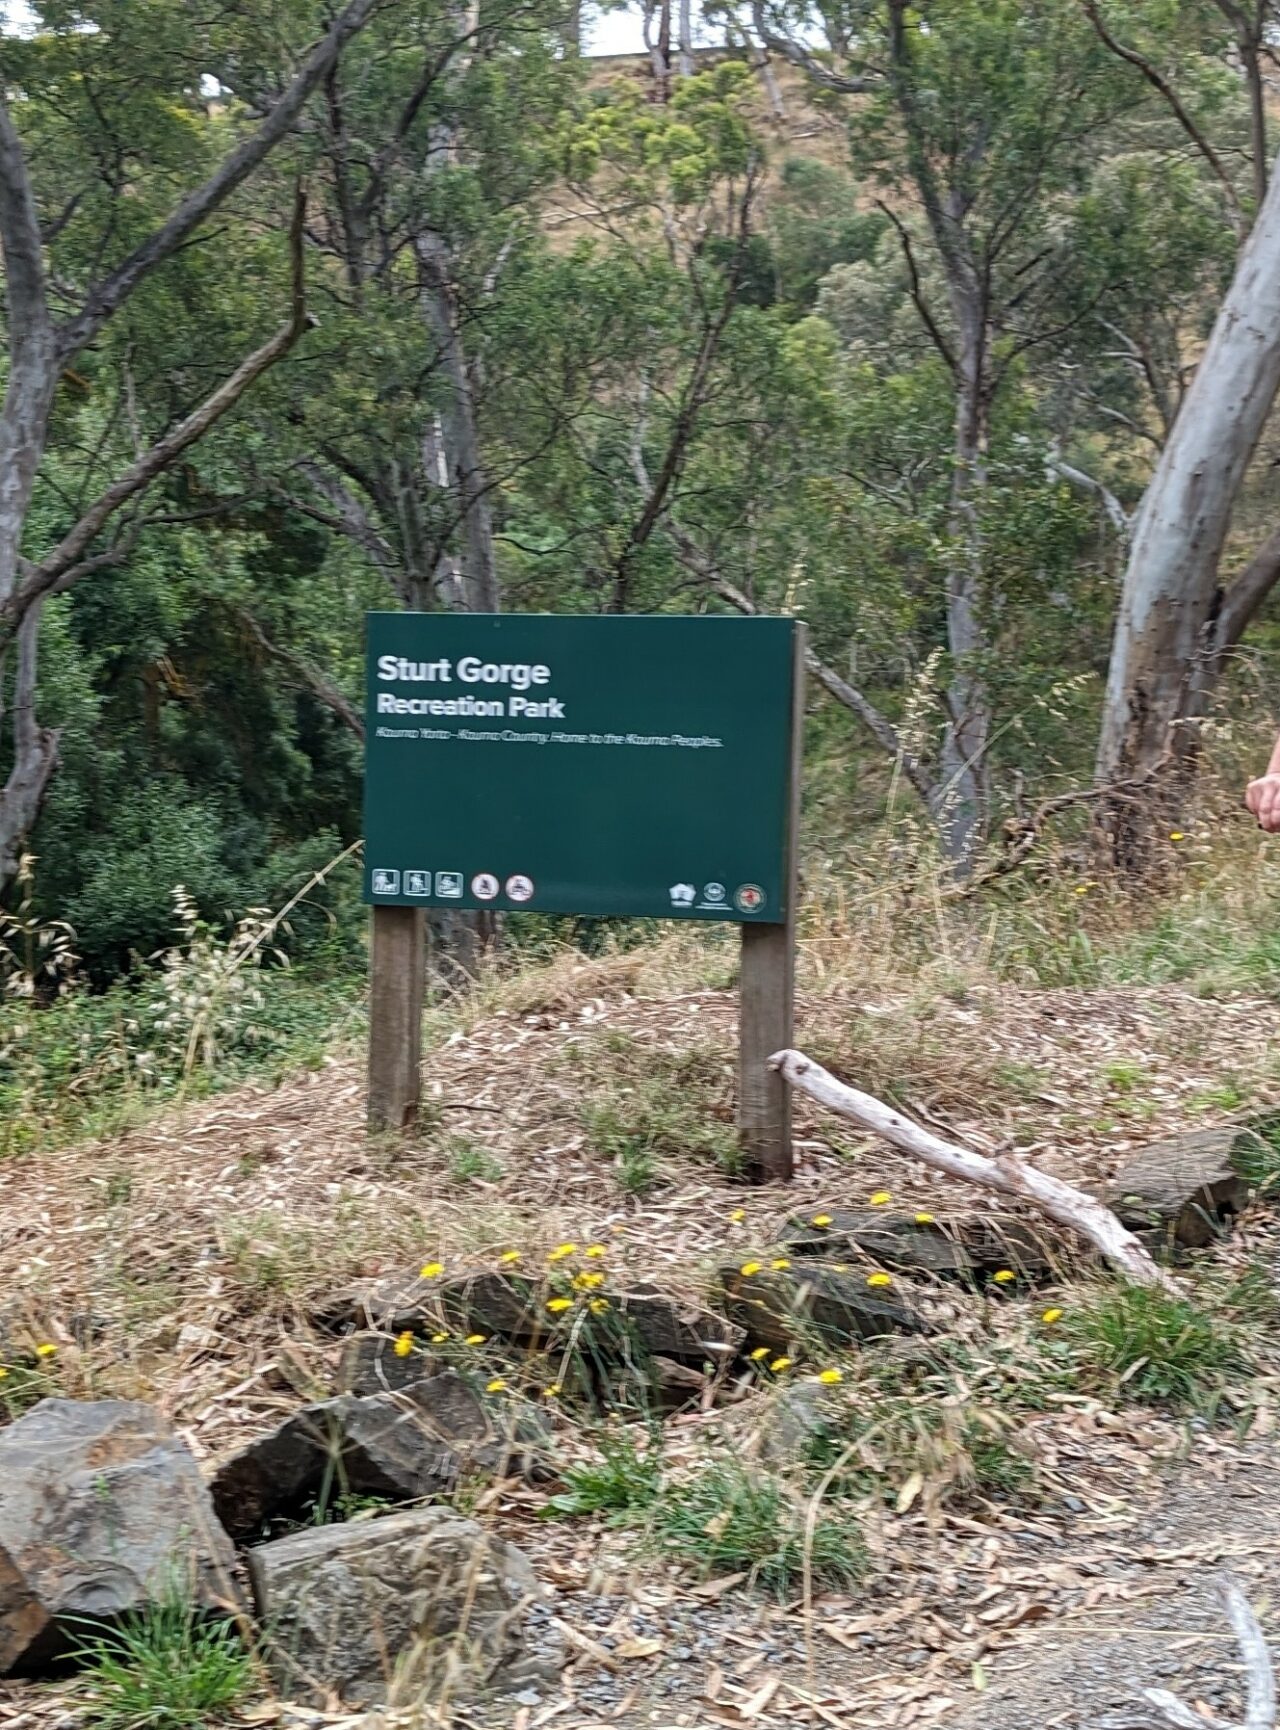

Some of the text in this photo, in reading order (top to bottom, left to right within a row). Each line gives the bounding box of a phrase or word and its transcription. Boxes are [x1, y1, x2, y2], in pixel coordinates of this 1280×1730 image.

[377, 655, 551, 690] Sturt Gorge
[377, 693, 566, 719] Recreation Park
[549, 731, 589, 744] Home
